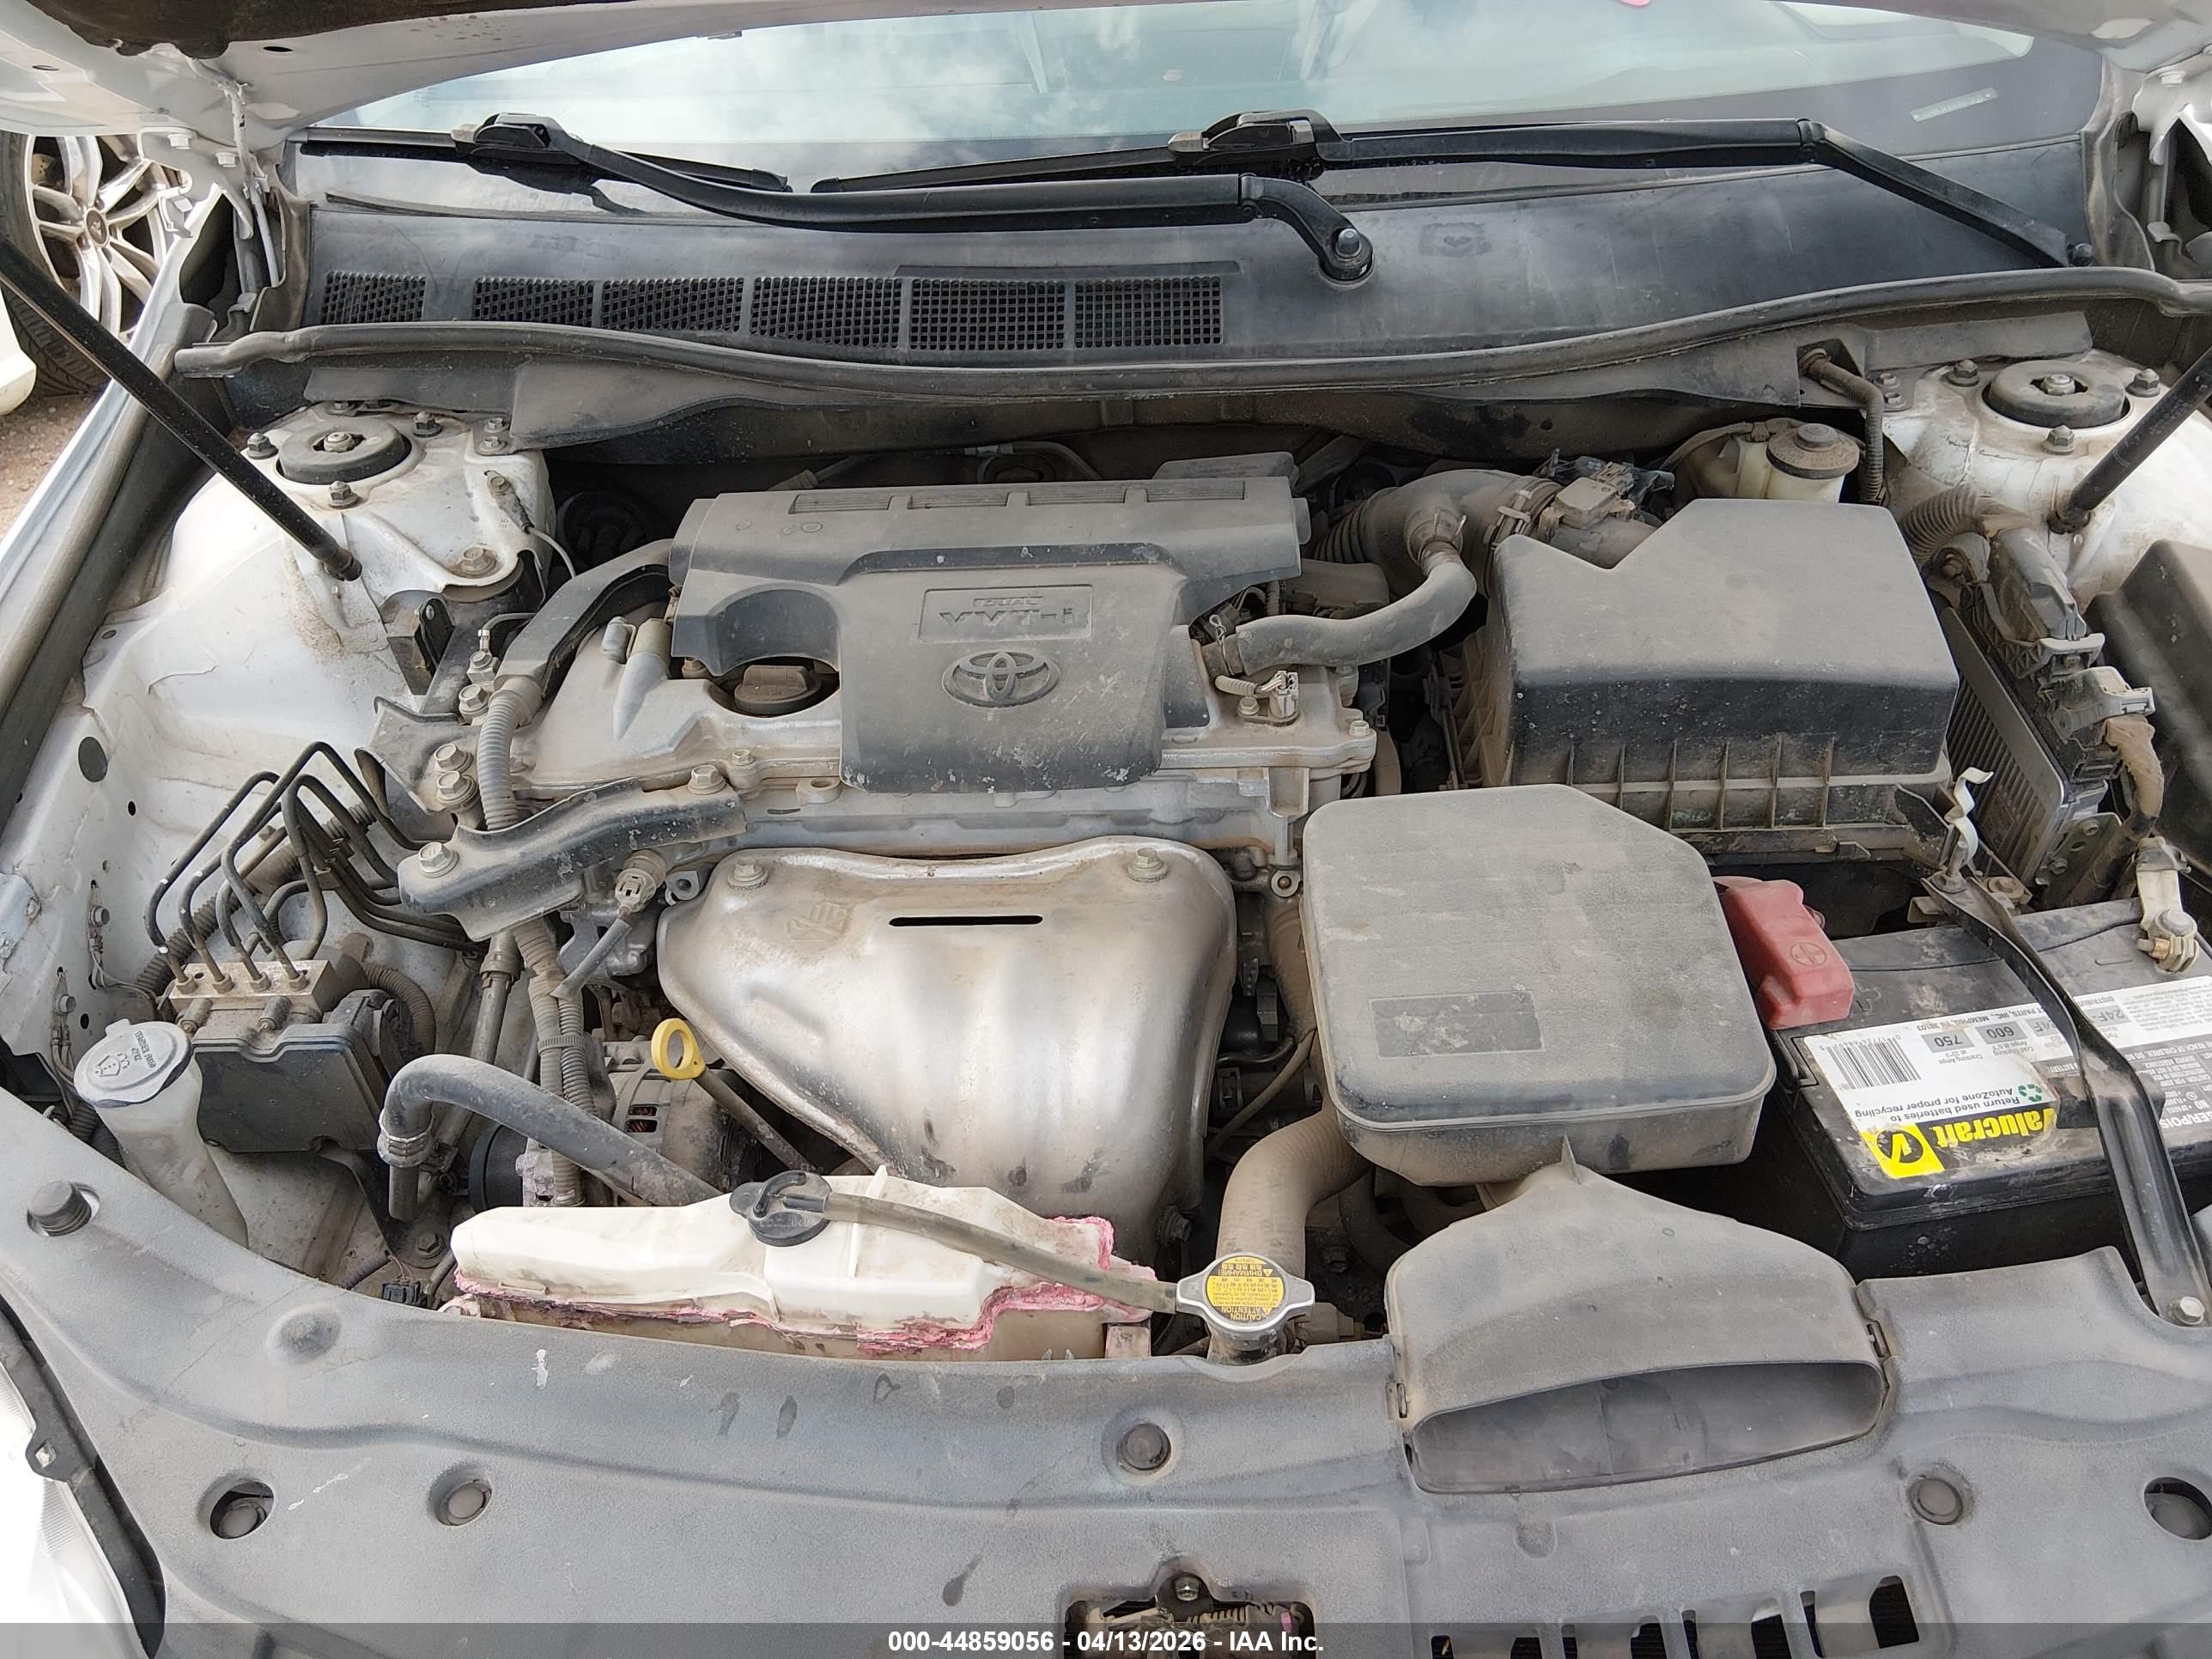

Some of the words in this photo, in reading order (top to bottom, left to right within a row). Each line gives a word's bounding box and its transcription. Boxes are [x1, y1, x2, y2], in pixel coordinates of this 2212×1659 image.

[939, 606, 1073, 628] VVT-i
[1986, 1026, 2014, 1039] 600
[1934, 1035, 1964, 1048] 750
[1944, 1095, 1960, 1105] for
[1962, 1087, 2014, 1102] AutoZone
[1906, 1098, 1942, 1110] proper
[1954, 1103, 1980, 1113] used
[1984, 1096, 2021, 1108] Return
[1855, 1104, 1904, 1118] recycling
[1905, 1106, 1953, 1120] batteries
[1890, 1114, 1902, 1122] to
[1221, 1305, 1261, 1314] ATTENTION
[1230, 1312, 1261, 1321] CAUTION
